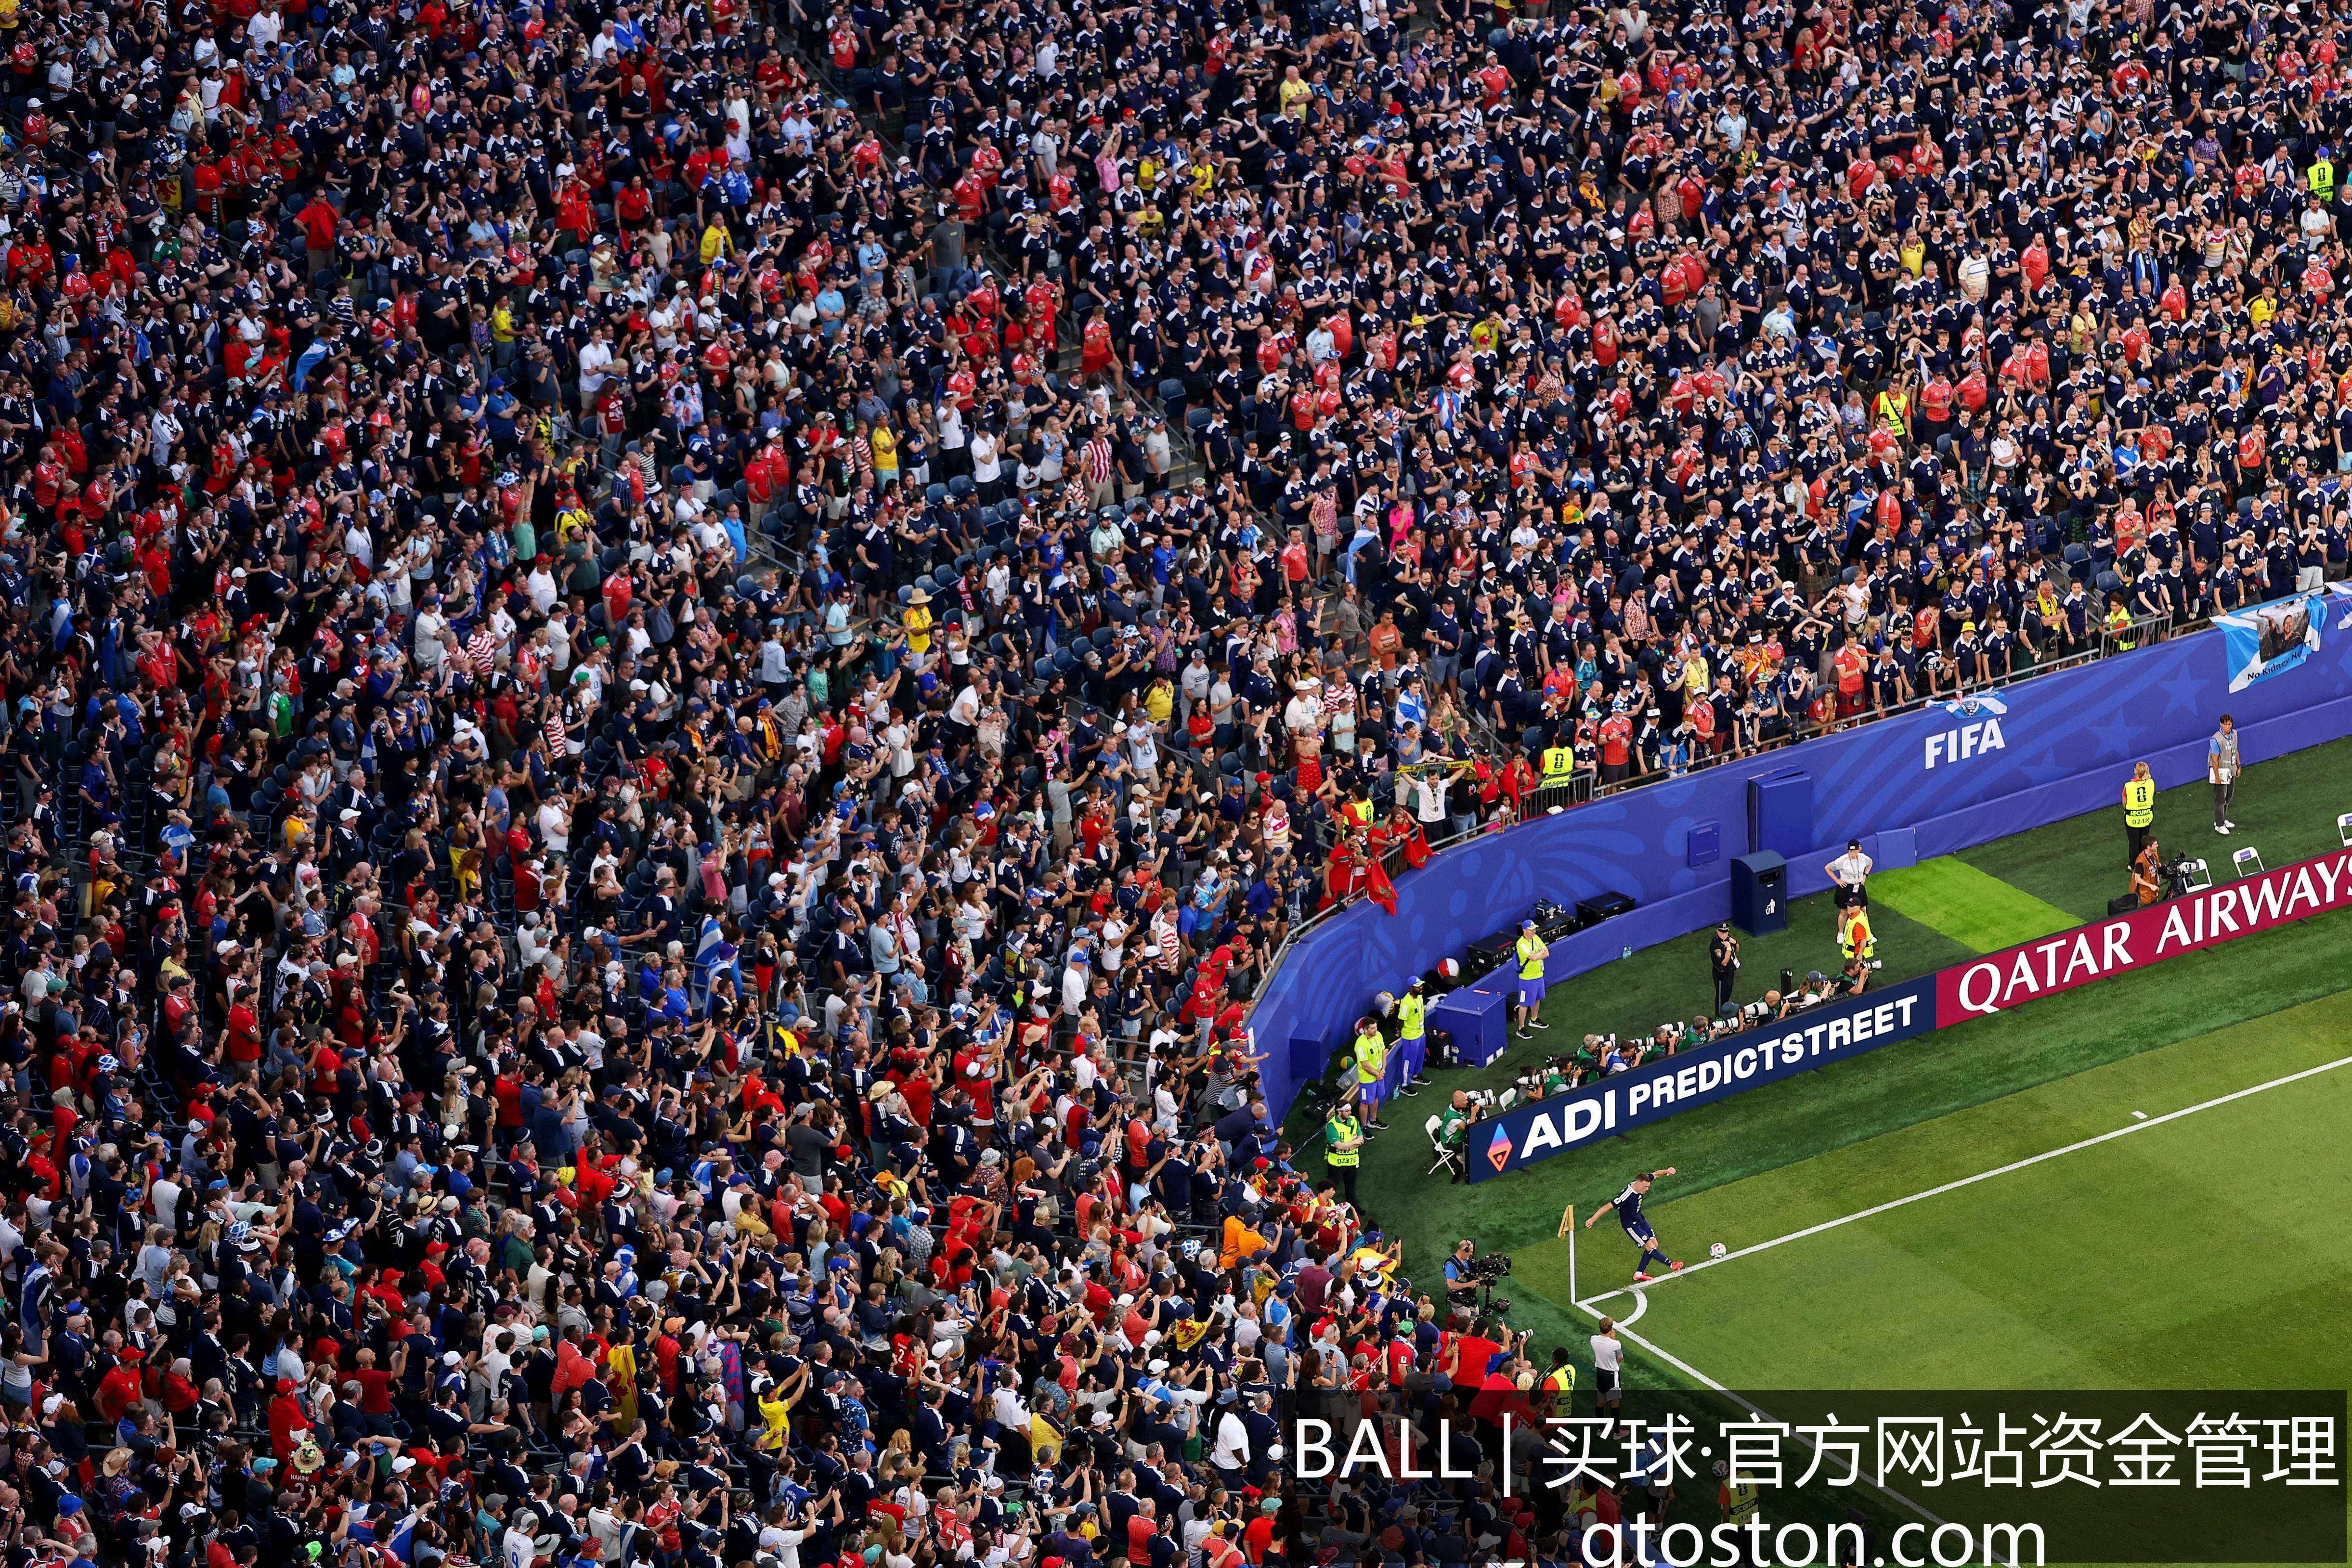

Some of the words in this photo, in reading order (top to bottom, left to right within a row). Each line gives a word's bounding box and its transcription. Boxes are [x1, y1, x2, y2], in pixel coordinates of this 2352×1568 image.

[2281, 457, 2289, 466] 64
[2247, 672, 2261, 681] No
[2262, 659, 2290, 676] Kidney
[2291, 651, 2302, 661] No
[1925, 718, 2005, 769] FIFA
[1959, 921, 2134, 1013] QATAR
[2156, 855, 2352, 954] AIRWAY
[1520, 1089, 1615, 1159] ADI
[1629, 995, 1918, 1116] PREDICTSTREET
[897, 1348, 904, 1363] 2
[291, 1474, 309, 1482] HAKIMI
[1733, 1499, 1755, 1515] SECURITY
